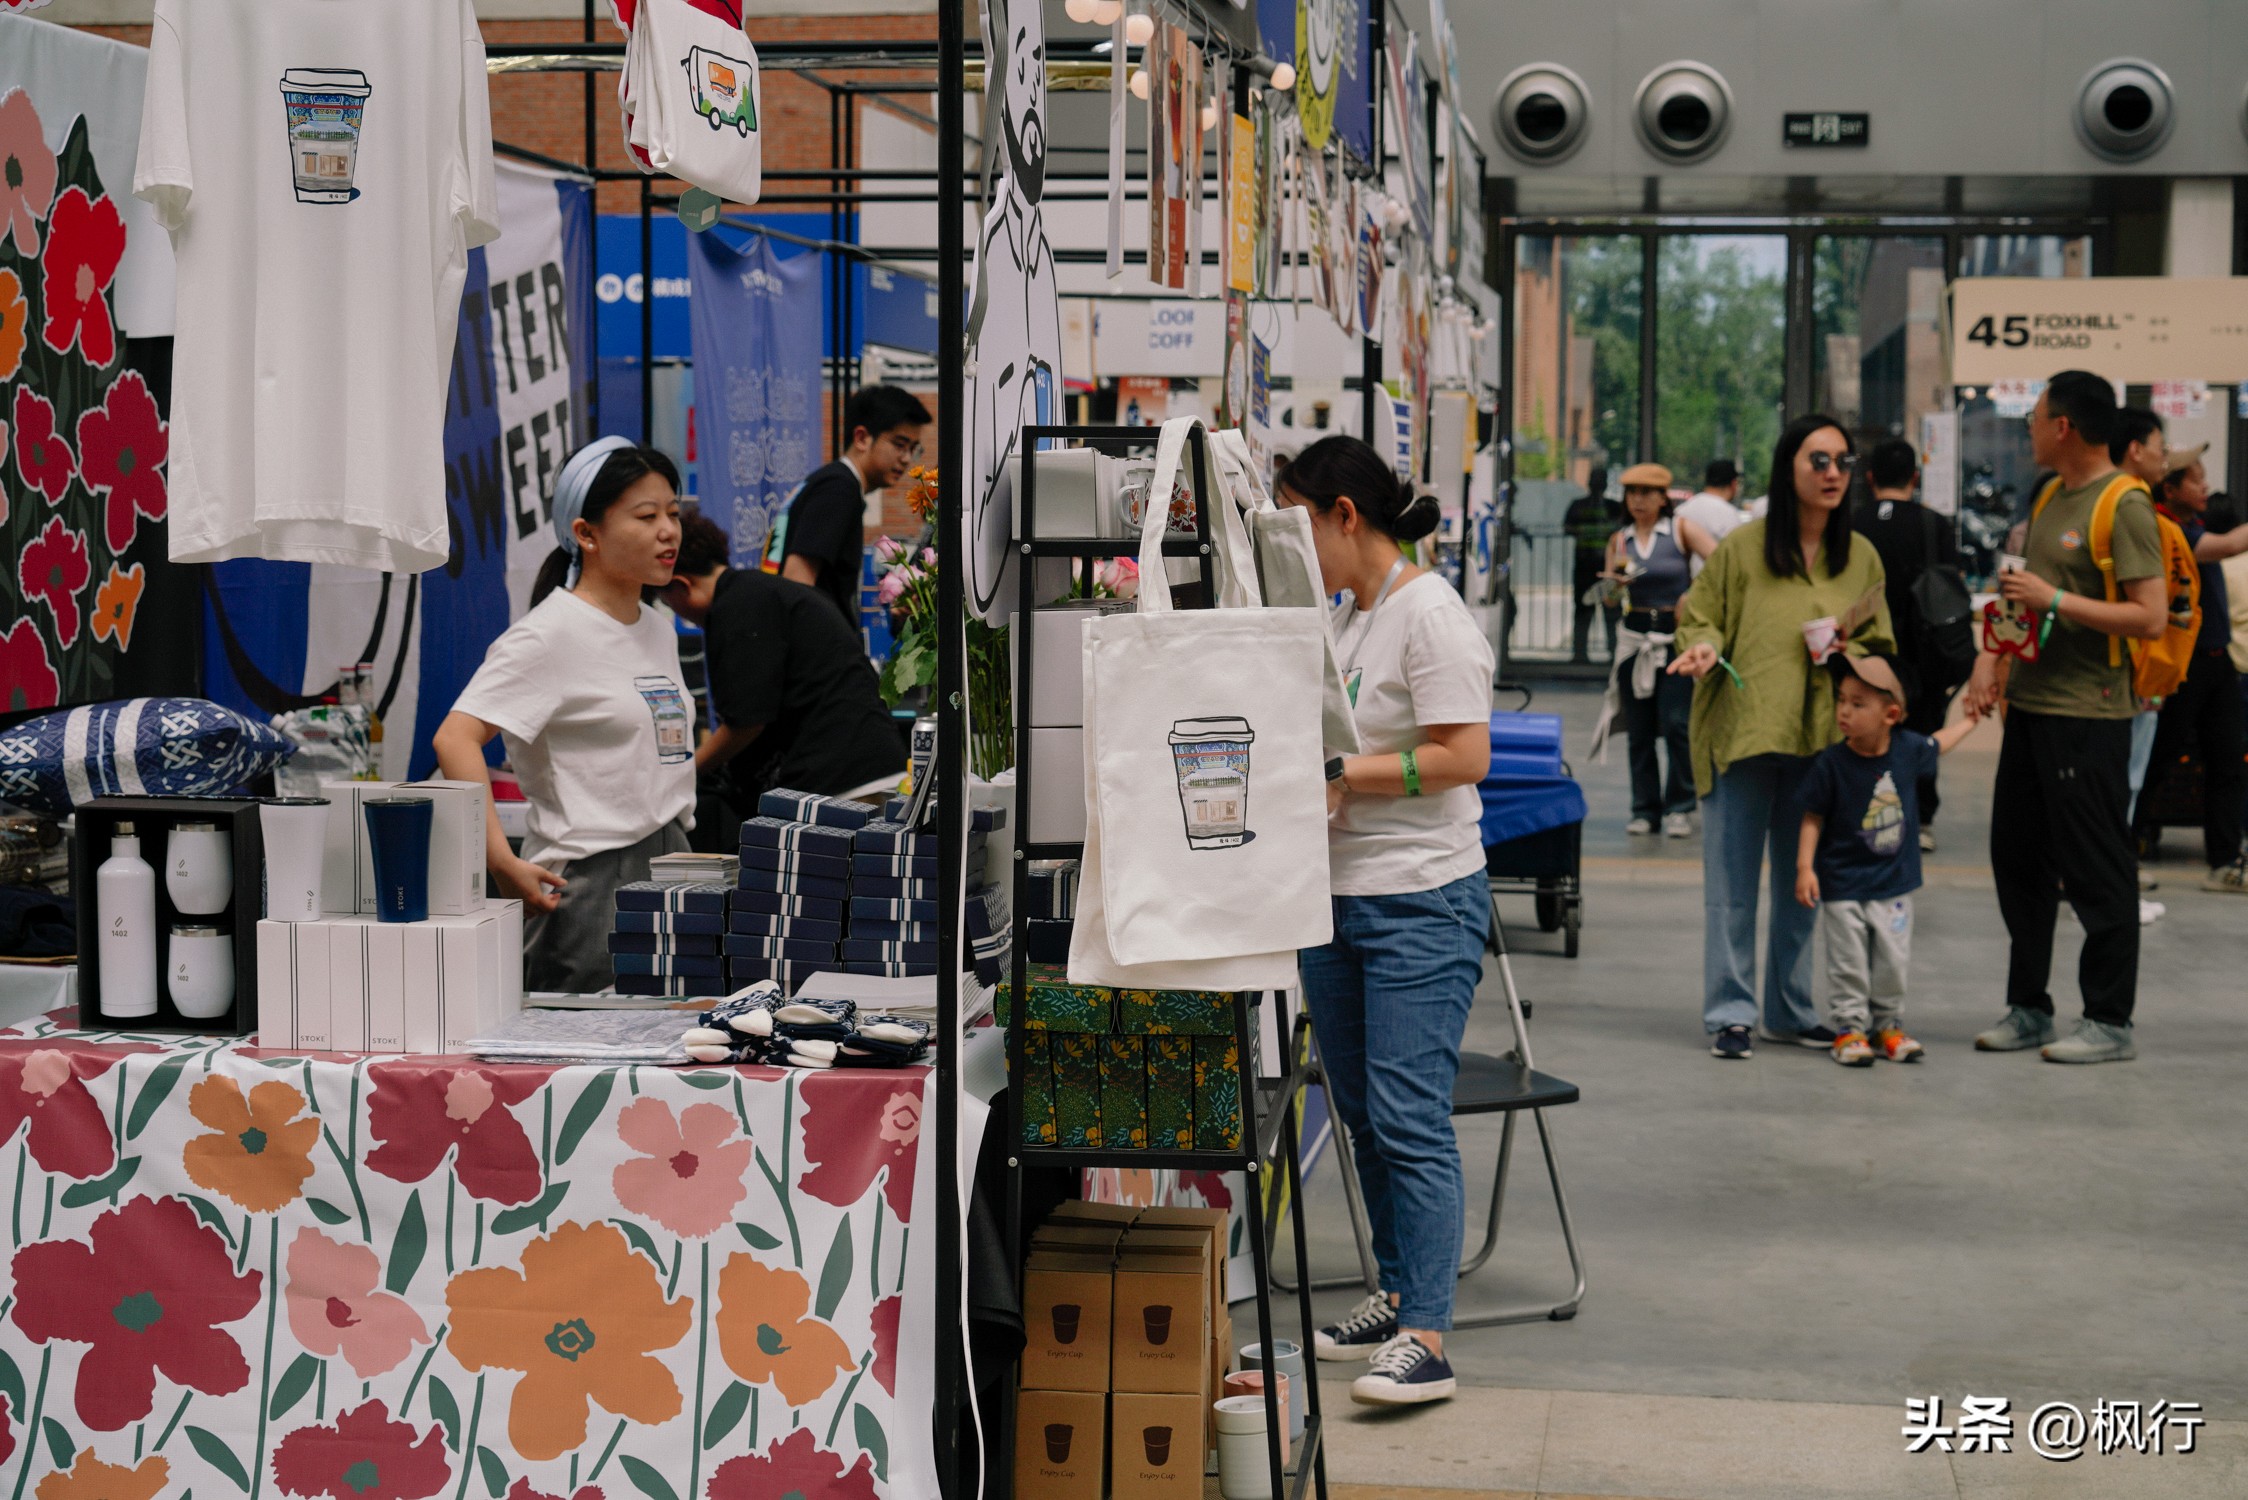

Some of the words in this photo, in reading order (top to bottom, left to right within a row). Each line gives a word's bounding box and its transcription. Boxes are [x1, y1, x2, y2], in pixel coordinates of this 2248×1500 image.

[1967, 313, 2031, 348] 45
[2033, 313, 2120, 330] FOXHILL
[2033, 334, 2091, 349] ROAD
[300, 1035, 325, 1043] STOKE
[372, 1037, 398, 1045] STOKE
[1047, 1350, 1067, 1358] Enjoy
[1139, 1351, 1159, 1359] Enjoy
[1161, 1351, 1175, 1359] Cup
[1040, 1469, 1060, 1477] Enjoy
[1061, 1470, 1076, 1478] Cup
[1139, 1472, 1159, 1480] Enjoy
[1161, 1472, 1175, 1480] Cup
